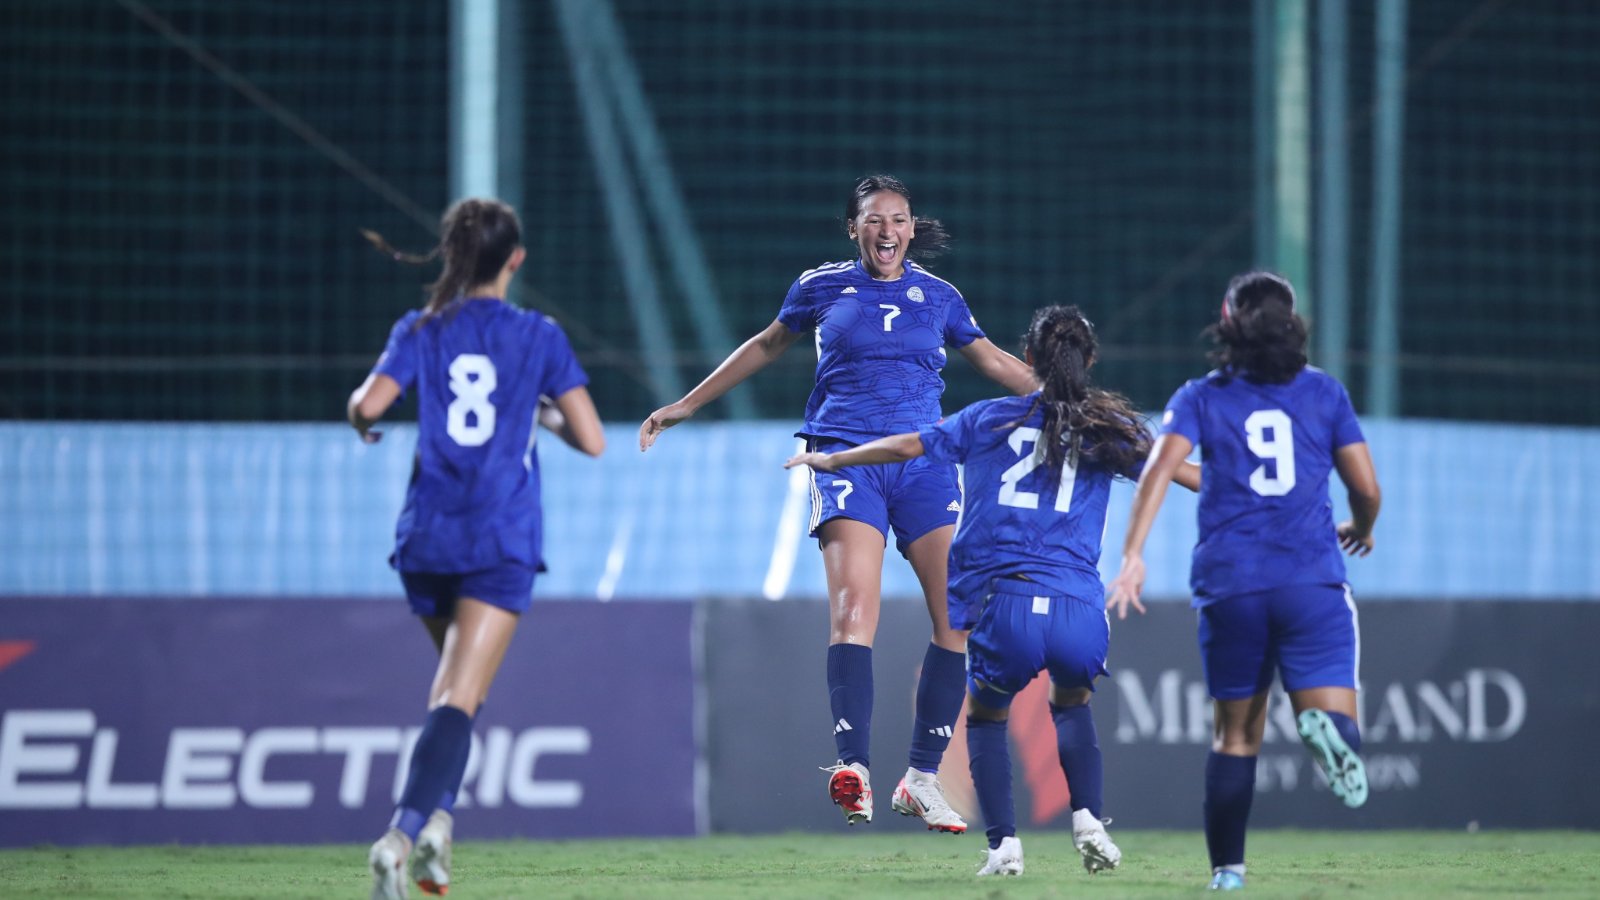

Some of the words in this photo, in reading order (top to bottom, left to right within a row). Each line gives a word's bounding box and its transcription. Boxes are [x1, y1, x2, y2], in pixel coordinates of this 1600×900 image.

[879, 303, 901, 332] 7
[447, 353, 497, 446] 8
[832, 479, 853, 510] 7
[998, 426, 1082, 513] 21
[1244, 409, 1296, 497] 9
